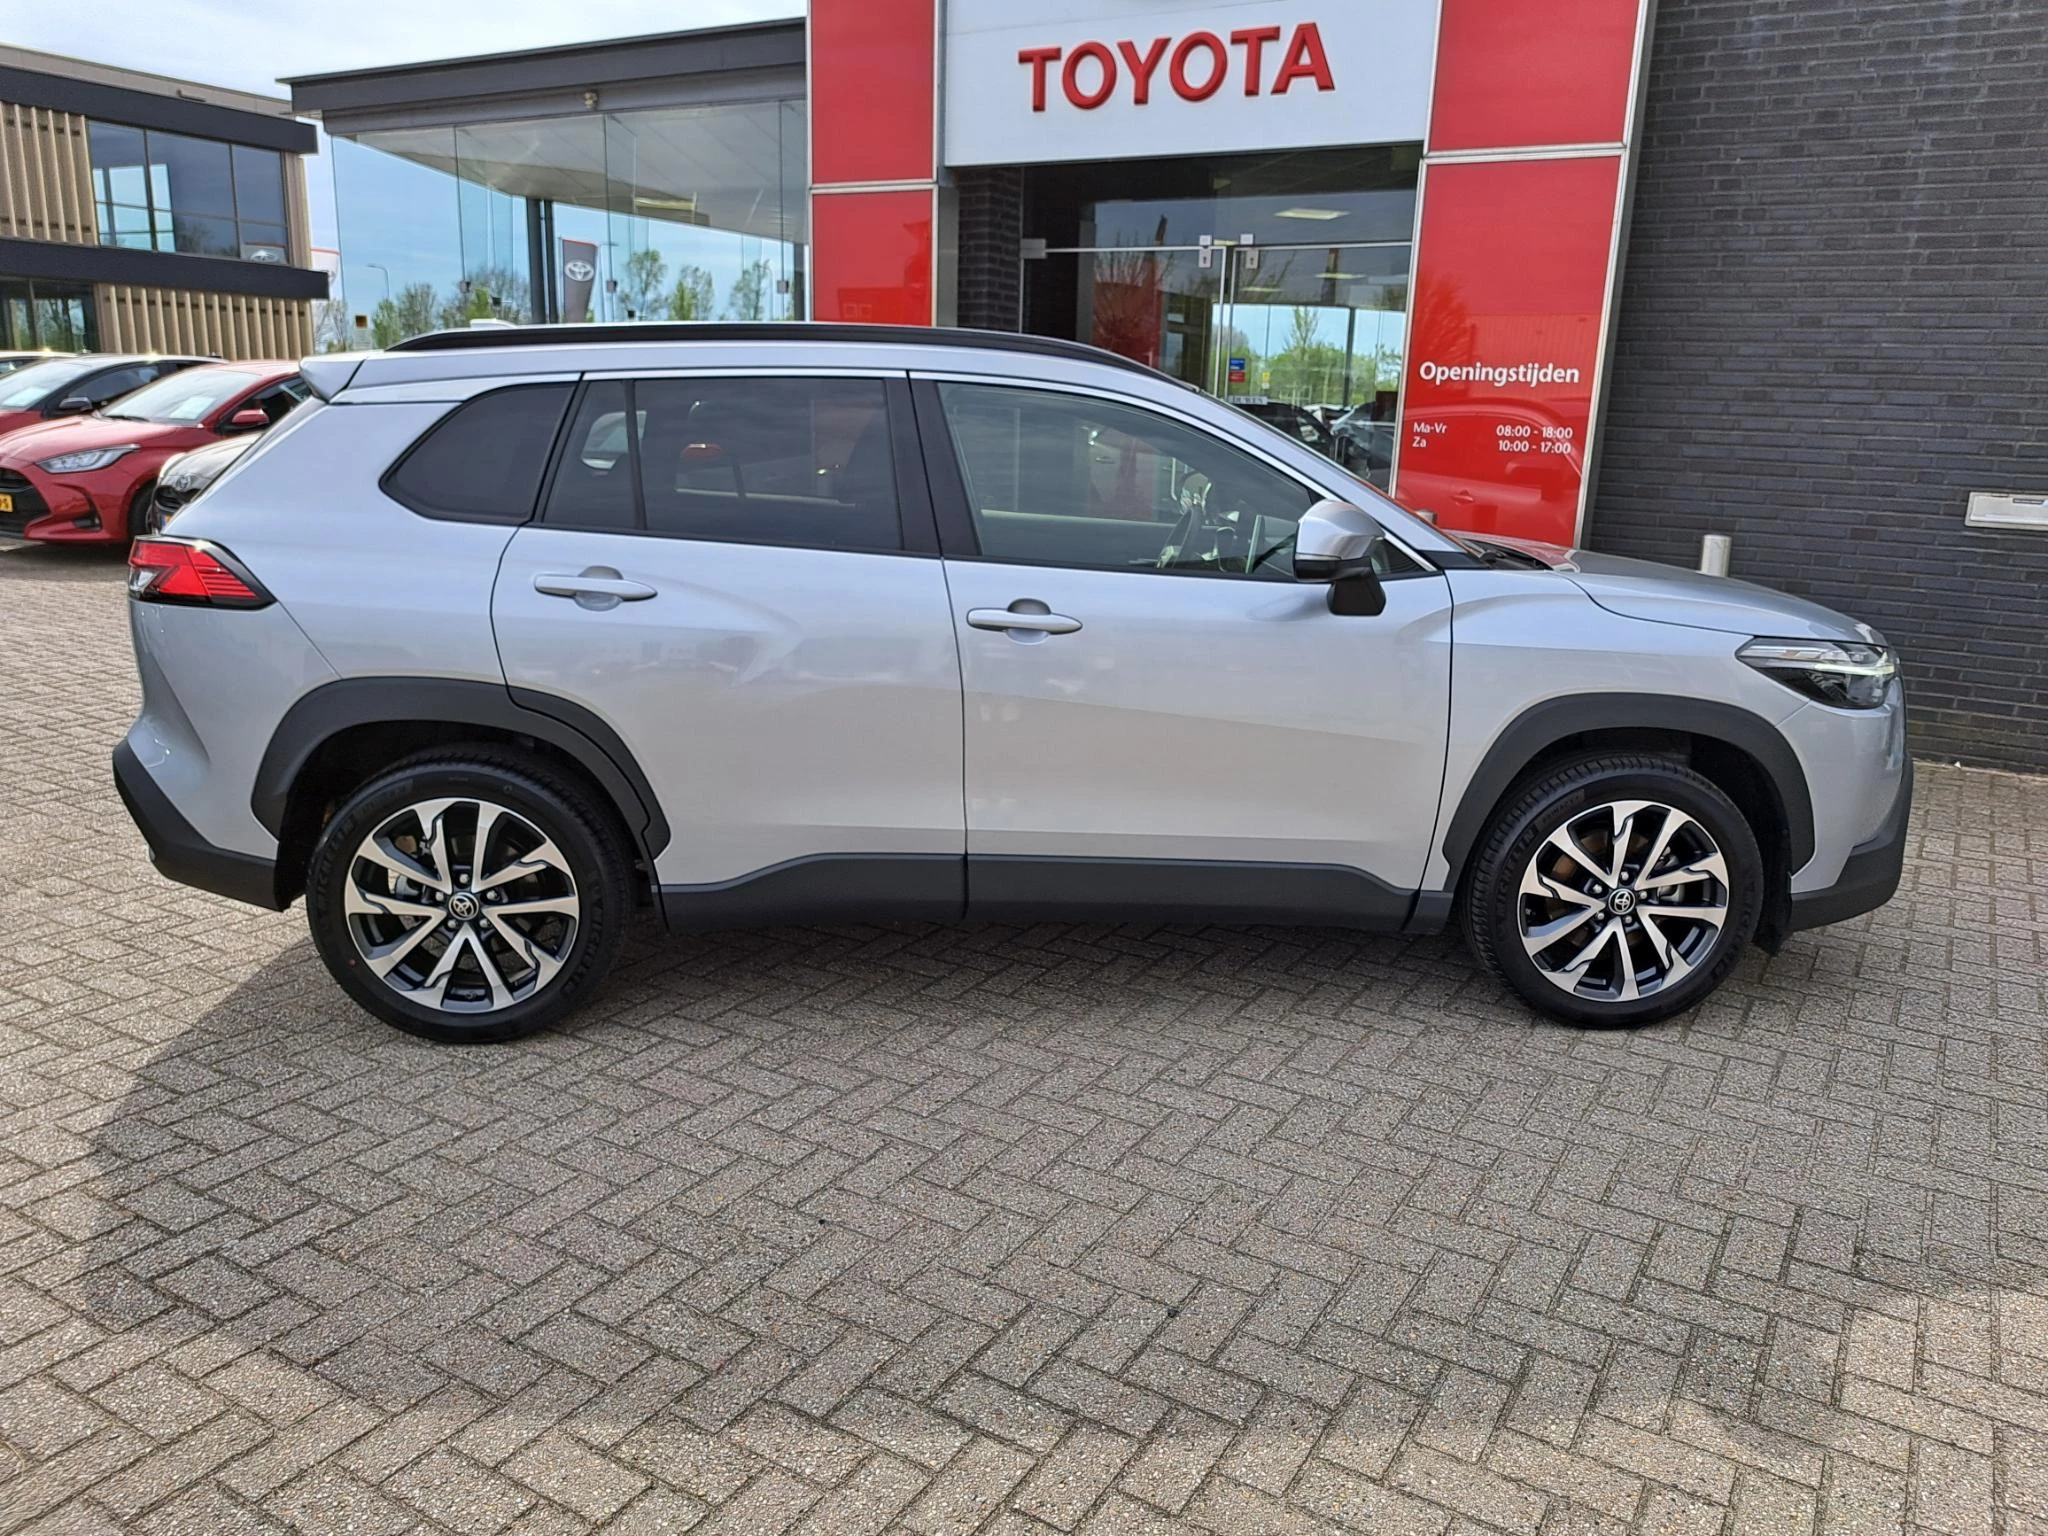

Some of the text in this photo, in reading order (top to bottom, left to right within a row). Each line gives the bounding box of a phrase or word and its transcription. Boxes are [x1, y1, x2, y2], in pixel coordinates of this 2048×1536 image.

[1018, 22, 1336, 112] TOYOTA
[1419, 361, 1579, 387] Openingstijden
[1413, 422, 1447, 434] Ma-Vr
[1496, 425, 1531, 438] 08:00
[1542, 426, 1573, 439] 18:00
[1412, 436, 1427, 448] Za
[1498, 440, 1529, 452] 10:00
[1541, 441, 1572, 454] 17:00
